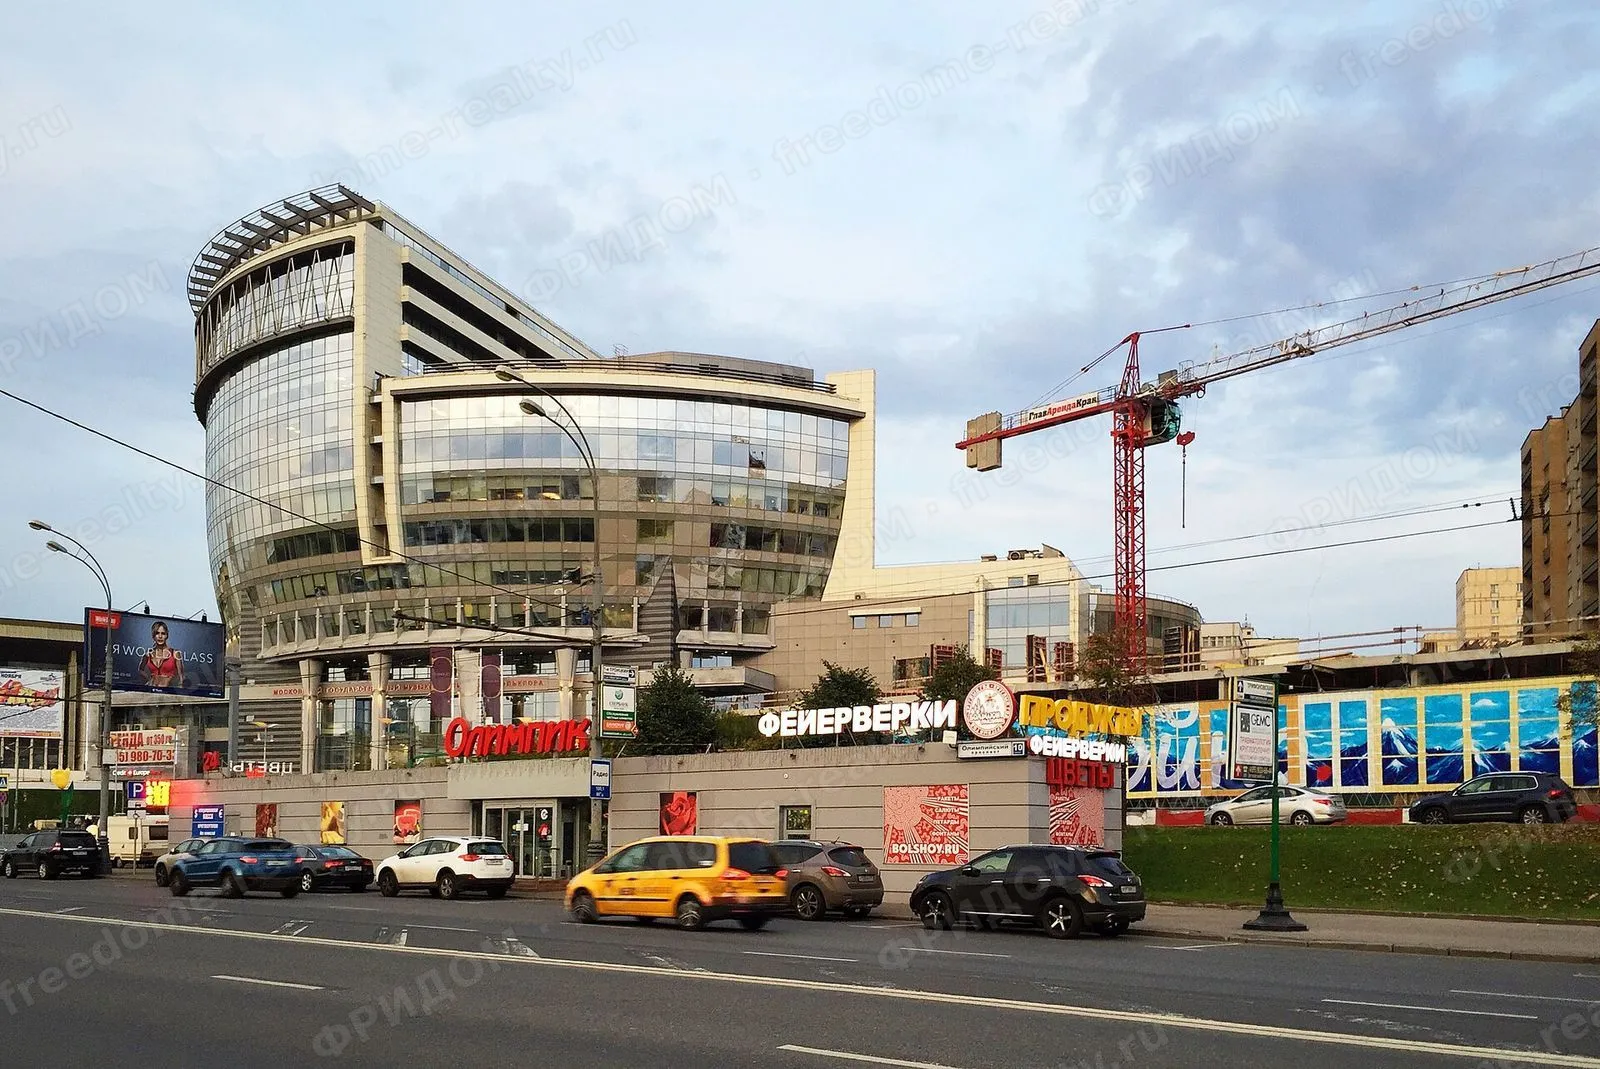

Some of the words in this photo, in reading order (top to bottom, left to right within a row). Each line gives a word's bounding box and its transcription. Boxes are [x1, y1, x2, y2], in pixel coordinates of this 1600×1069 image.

[1029, 394, 1097, 421] ГлавАрендаКран
[1019, 694, 1142, 737] ПРОДУКТЫ
[1250, 713, 1271, 727] GEMC
[131, 749, 175, 762] 980-70-3
[593, 770, 608, 778] Радио
[1046, 757, 1115, 789] ЦВЕТЫ
[892, 843, 960, 854] BOLSHOY.RU
